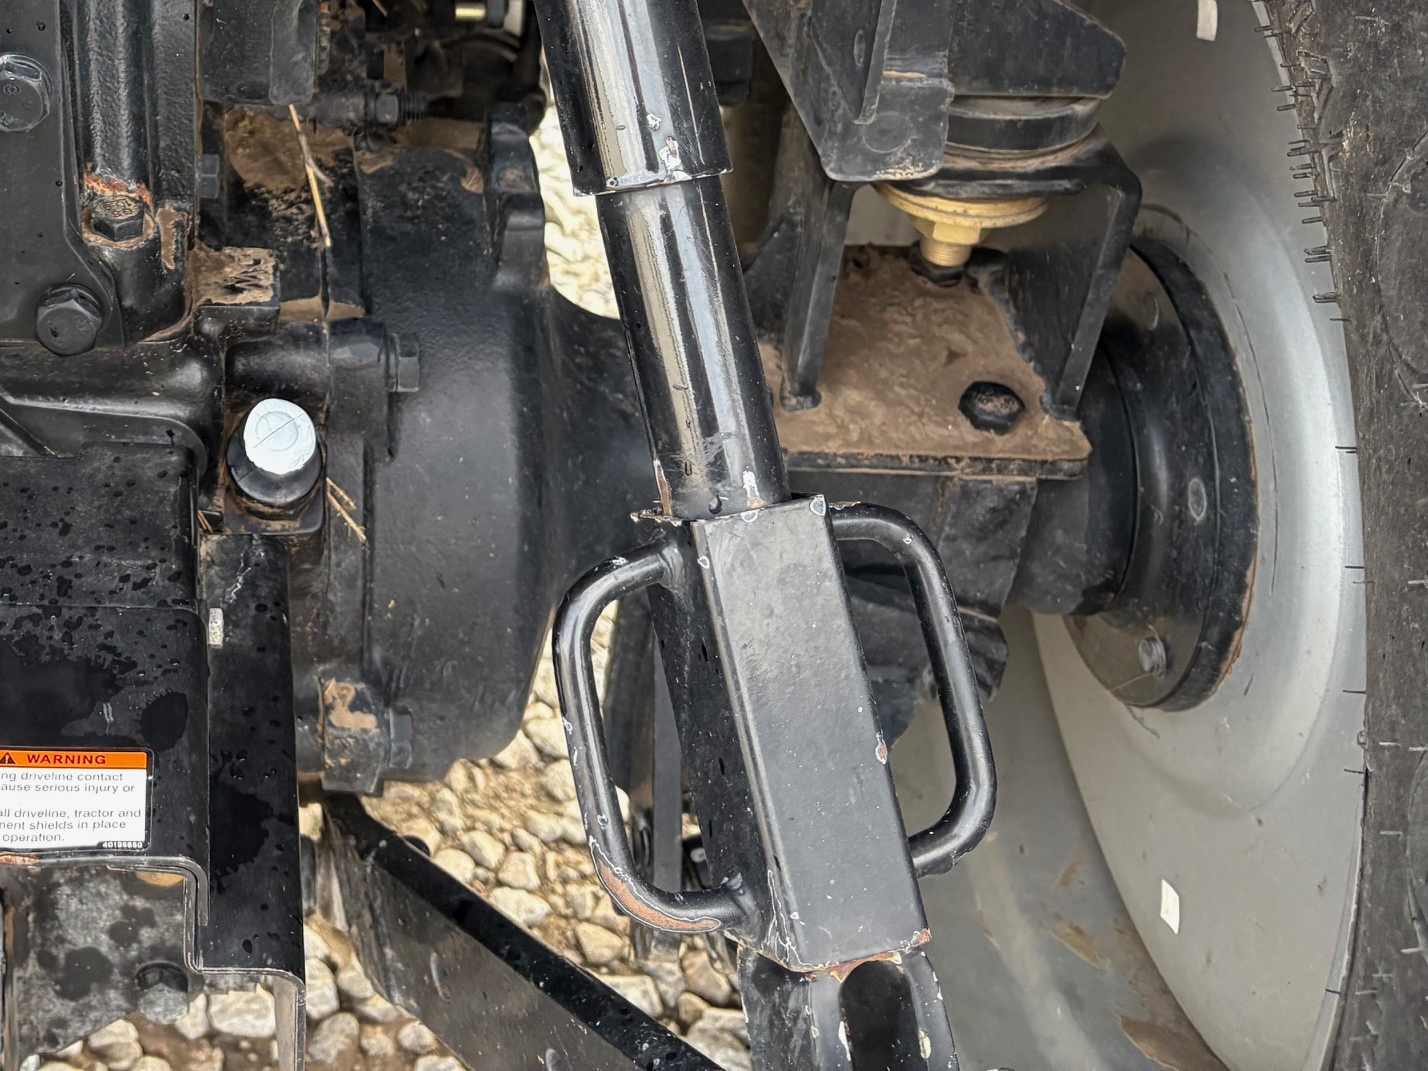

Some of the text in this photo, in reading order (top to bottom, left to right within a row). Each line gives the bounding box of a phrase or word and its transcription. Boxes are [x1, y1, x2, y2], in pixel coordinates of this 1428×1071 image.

[26, 753, 107, 765] WARNING
[20, 771, 74, 781] driveline
[77, 773, 124, 781] contact
[35, 783, 81, 792] serious
[84, 782, 119, 795] injury
[122, 784, 136, 792] or
[14, 808, 70, 819] driveline,
[74, 809, 114, 818] tractor
[118, 808, 142, 818] and
[29, 820, 74, 830] shields
[77, 819, 89, 829] in
[92, 819, 127, 831] place
[2, 832, 66, 844] operation.
